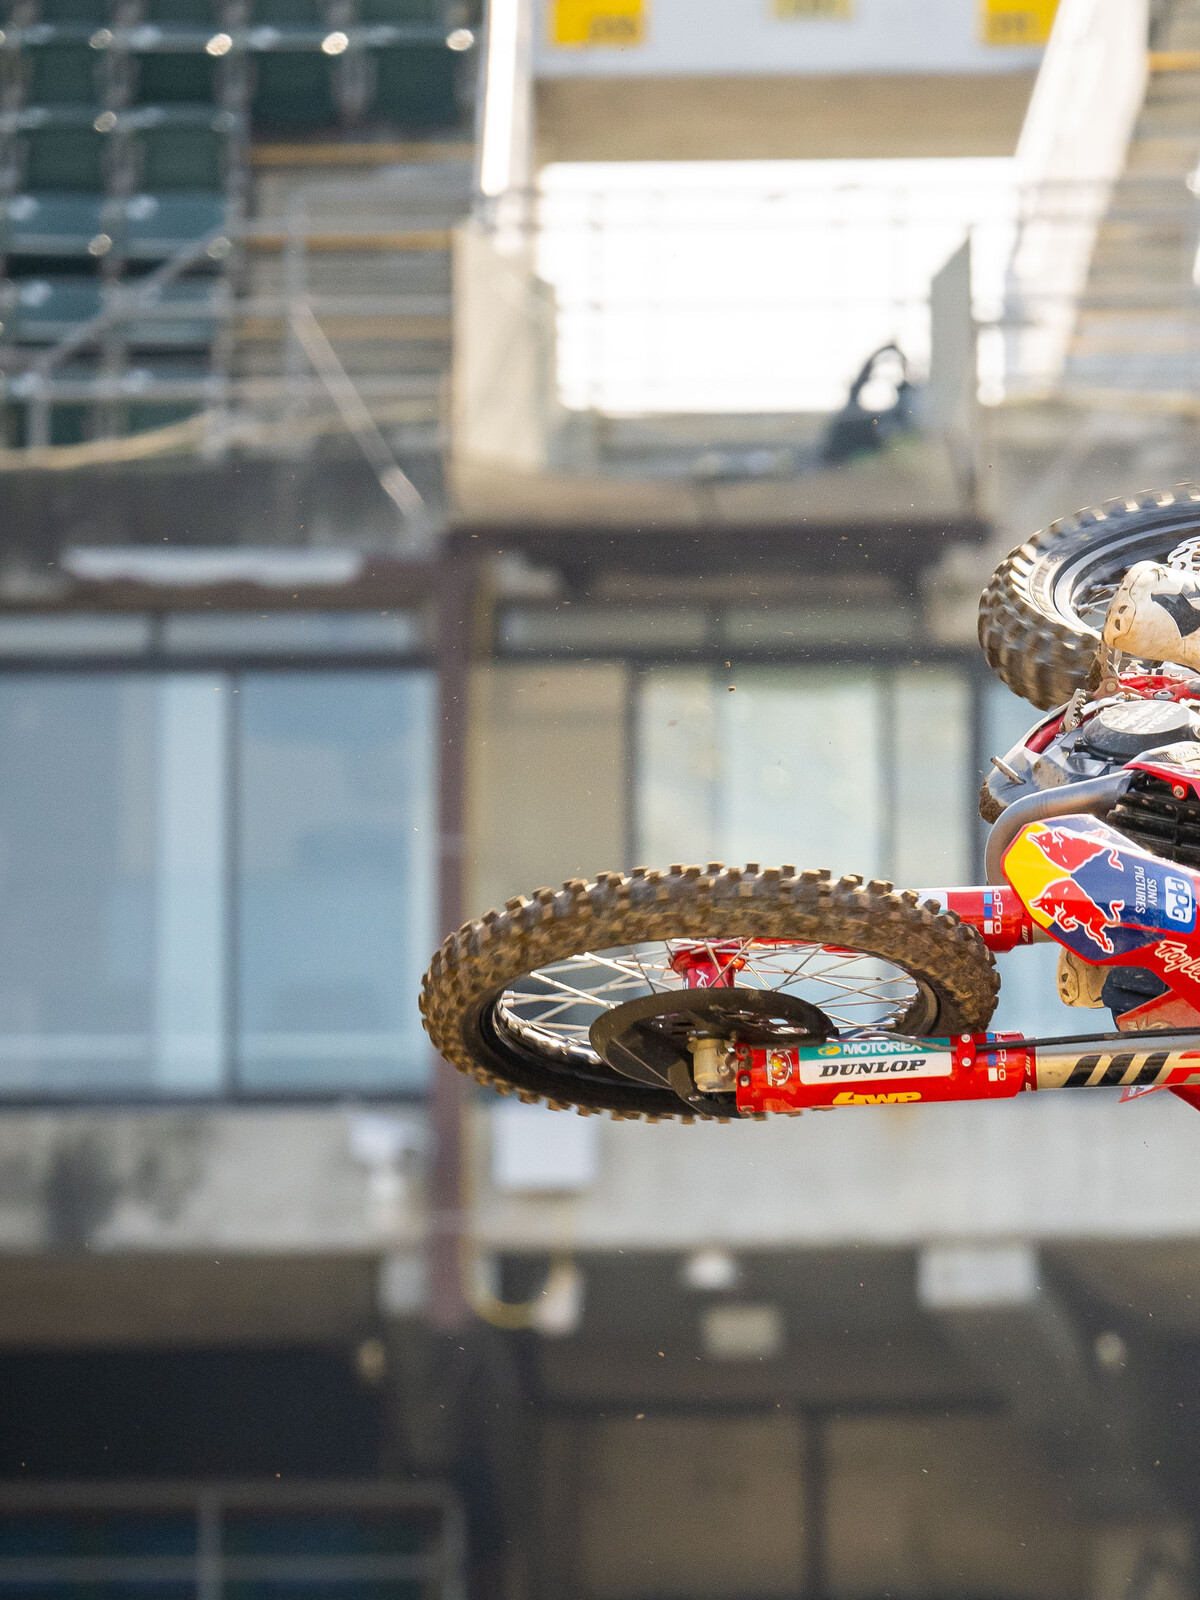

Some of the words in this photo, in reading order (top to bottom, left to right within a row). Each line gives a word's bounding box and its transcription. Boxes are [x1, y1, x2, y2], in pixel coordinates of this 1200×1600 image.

[1134, 865, 1146, 915] PICTURES
[1146, 878, 1158, 908] SONY
[1167, 877, 1192, 923] PPG
[1155, 940, 1192, 973] Troy
[819, 1059, 926, 1078] DUNLOP
